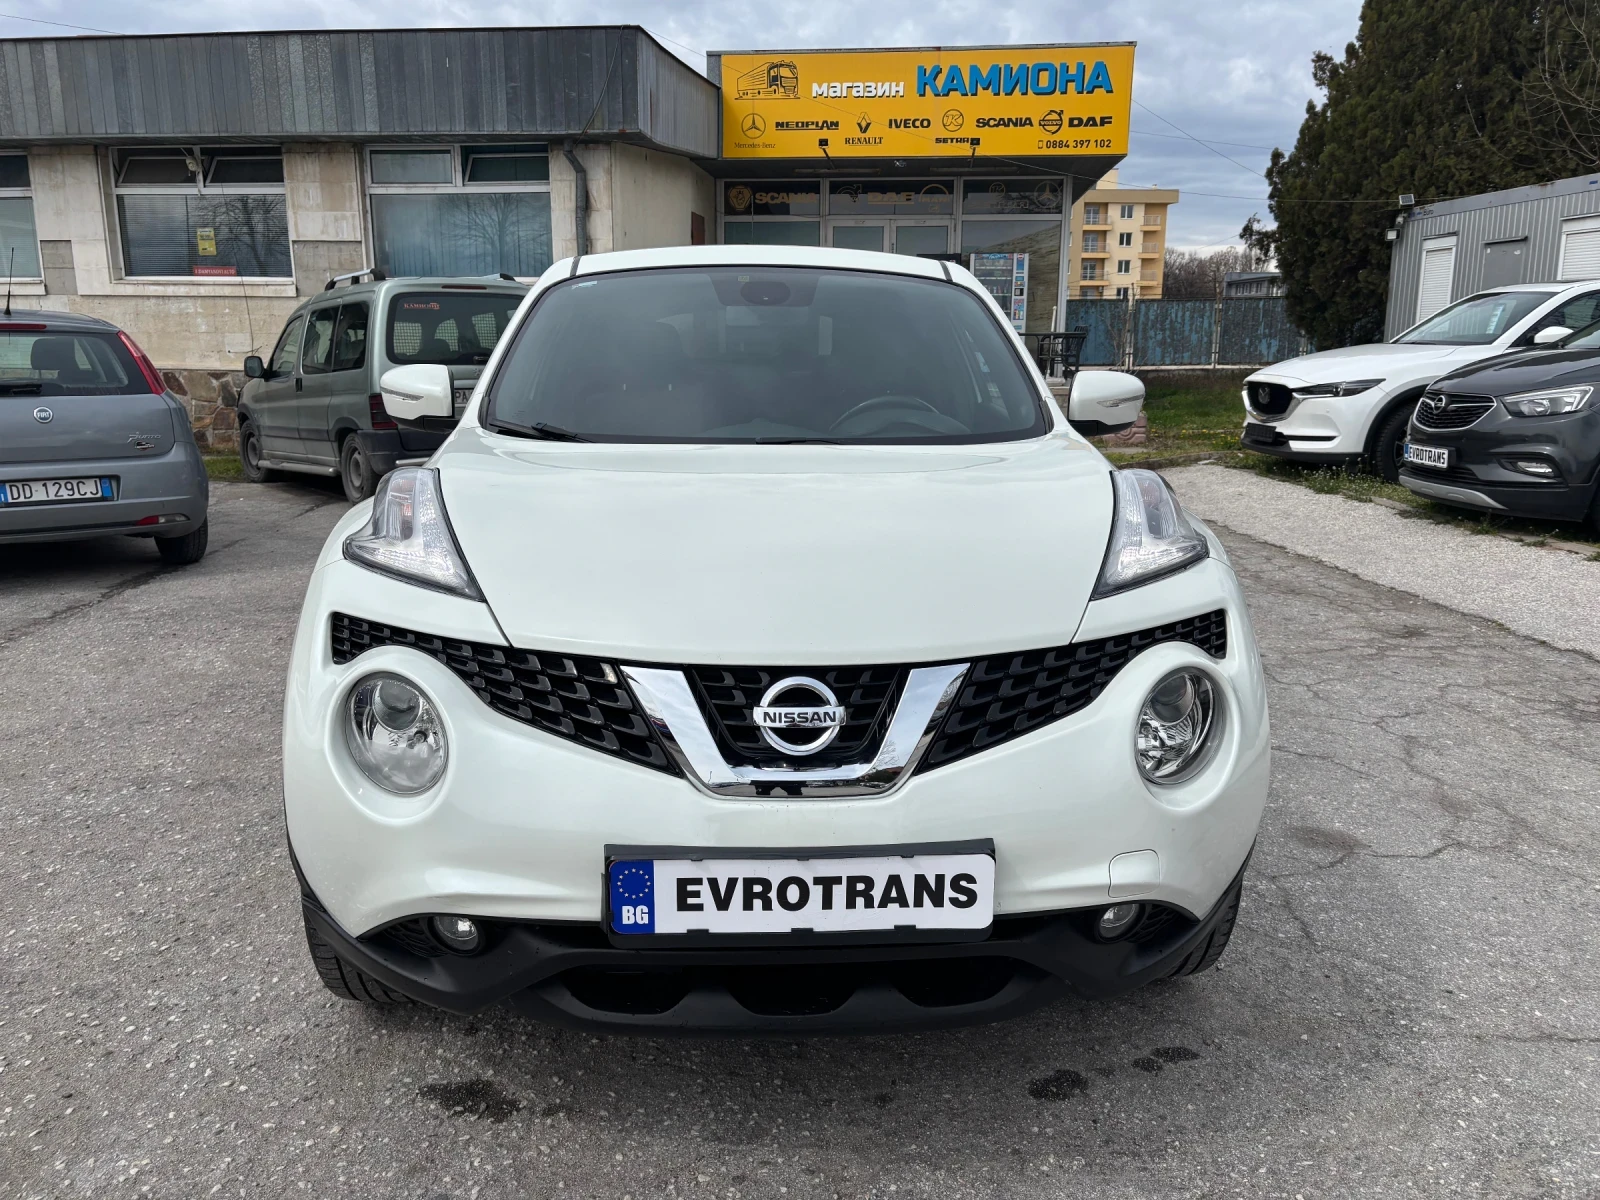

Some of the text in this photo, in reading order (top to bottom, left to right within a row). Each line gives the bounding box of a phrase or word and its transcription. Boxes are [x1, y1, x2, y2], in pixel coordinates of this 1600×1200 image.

[812, 61, 1113, 98] магазин КАМИОНА
[775, 120, 839, 130] NEOPLAN
[888, 118, 931, 129] IVECO
[976, 117, 1034, 128] SCANIA
[1068, 116, 1113, 128] DAF
[845, 137, 883, 145] RENAULT
[1045, 139, 1112, 149] 0884 397 102
[755, 192, 817, 204] SCANIA
[1409, 446, 1446, 465] EVROTRANS
[9, 479, 99, 500] DD 129CJ
[763, 711, 837, 723] NISSAN
[676, 873, 979, 912] EVROTRANS
[622, 905, 649, 925] BG
